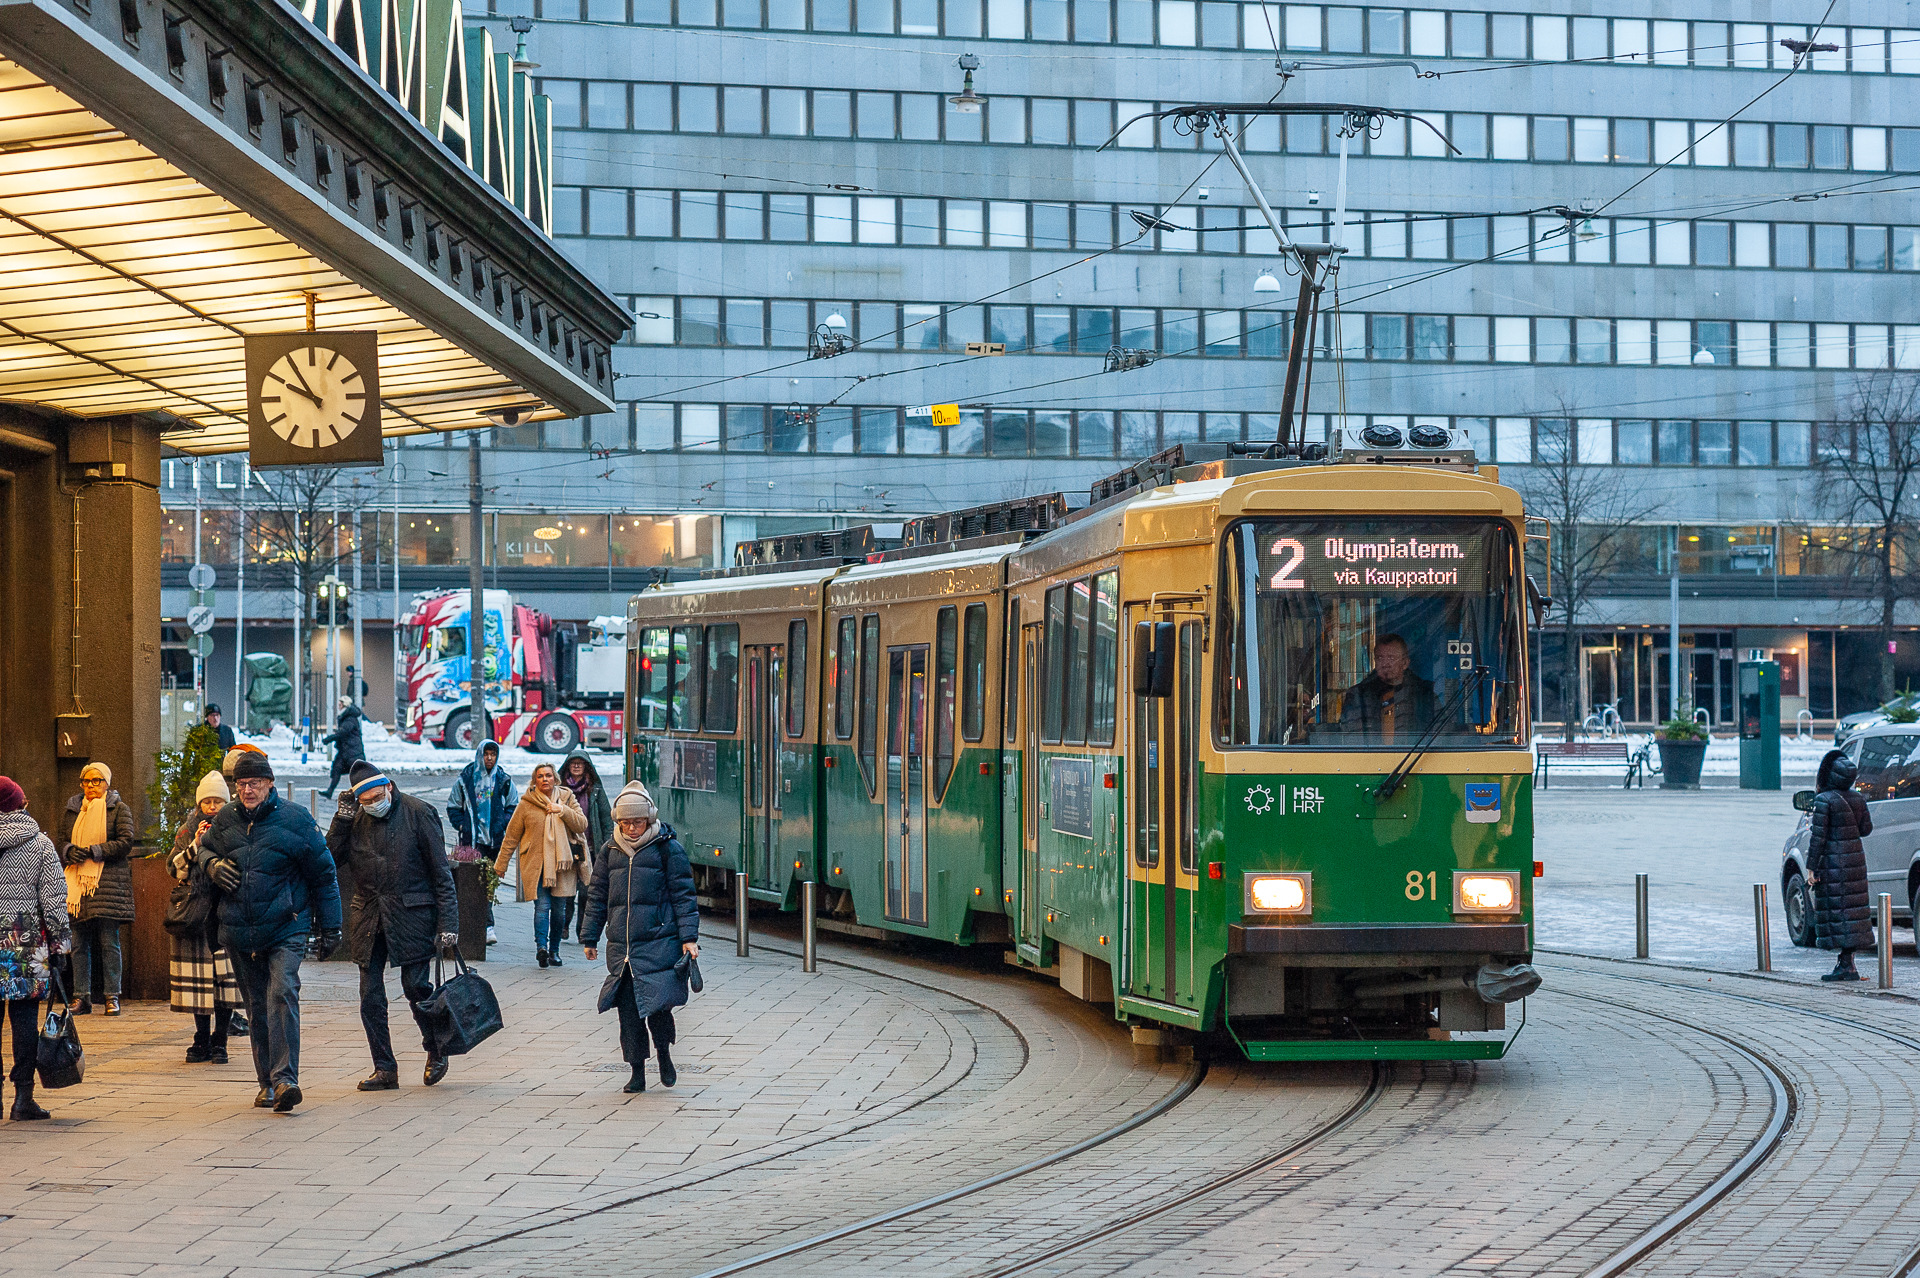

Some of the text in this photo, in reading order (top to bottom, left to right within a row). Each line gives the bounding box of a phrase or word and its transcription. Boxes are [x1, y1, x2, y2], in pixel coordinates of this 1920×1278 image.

[1271, 538, 1465, 588] 2 Olympiaterm.
[1334, 568, 1458, 588] via Kauppatori
[1293, 787, 1324, 800] HSL
[1293, 800, 1324, 813] HRT
[1405, 870, 1436, 901] 81
